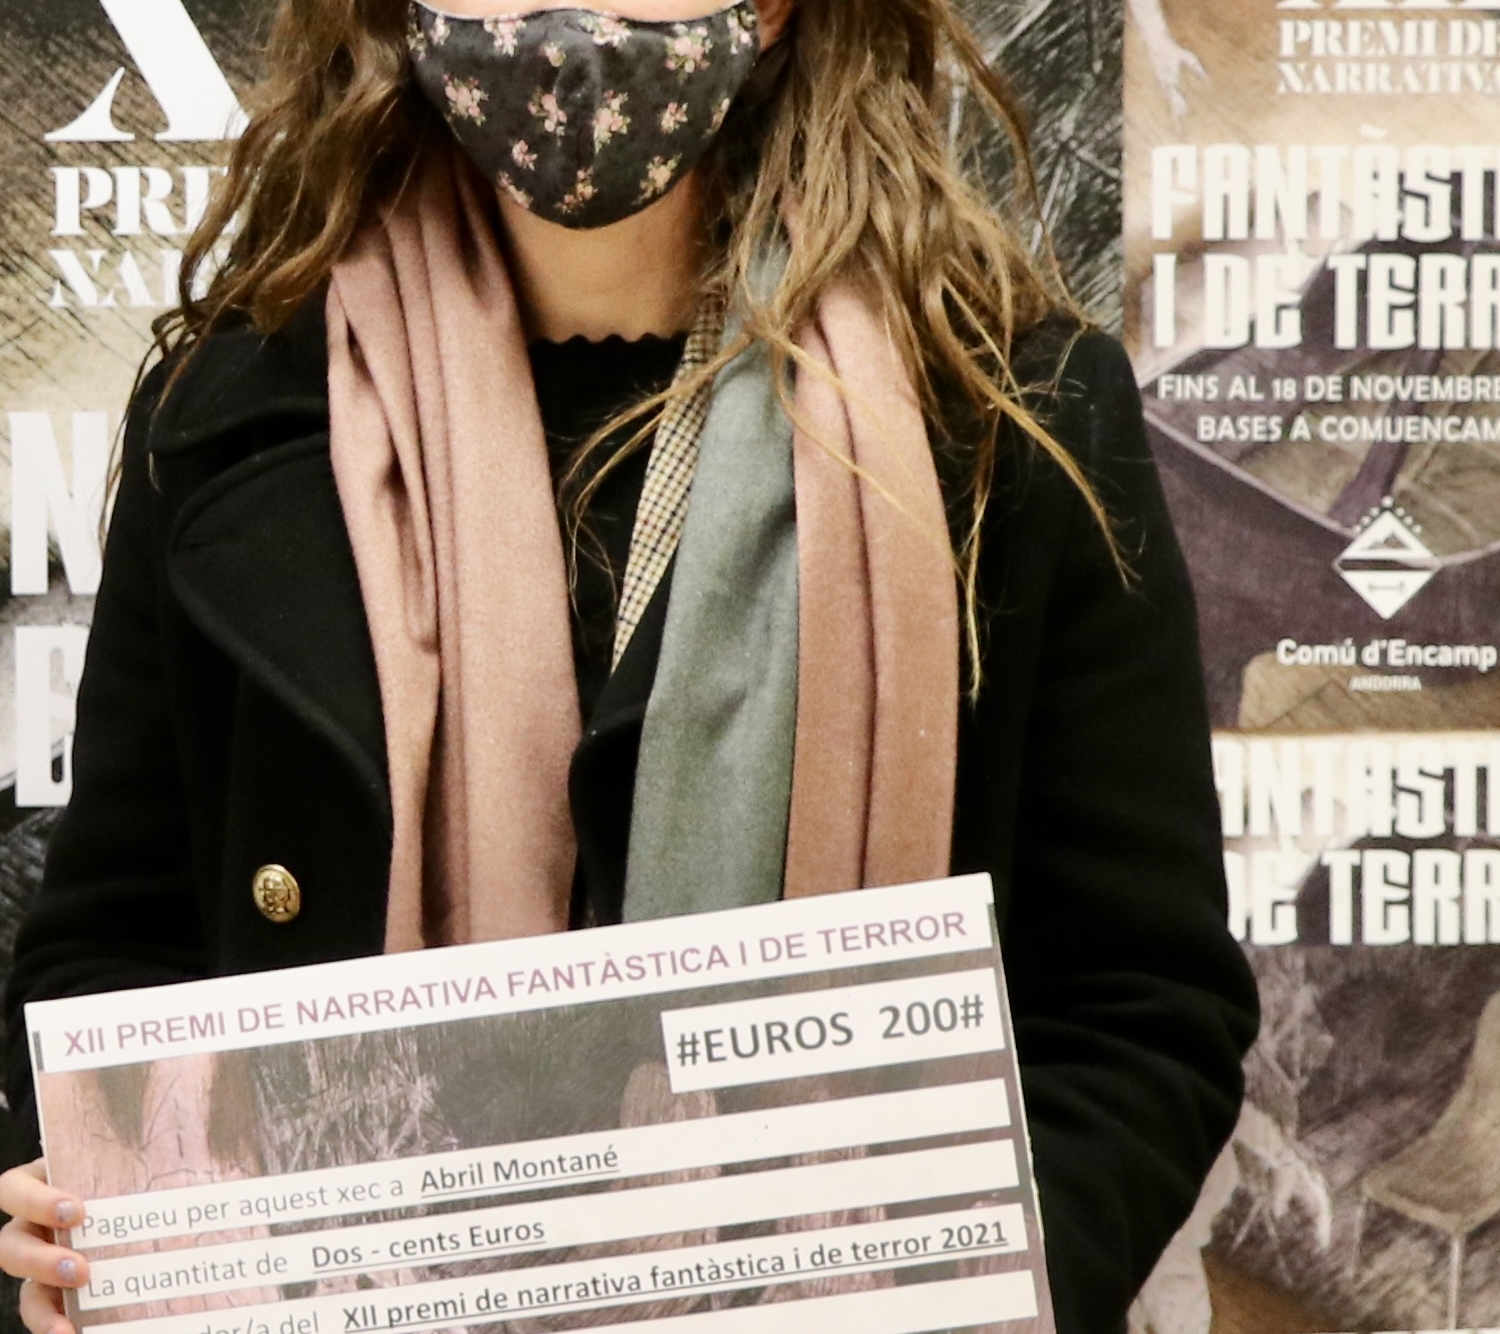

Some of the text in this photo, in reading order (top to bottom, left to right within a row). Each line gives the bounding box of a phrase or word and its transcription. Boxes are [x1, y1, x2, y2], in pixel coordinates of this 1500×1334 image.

[1278, 18, 1443, 58] PREMI
[1151, 253, 1179, 349] I
[1203, 253, 1304, 349] DE
[1158, 375, 1218, 402] FINS
[1228, 376, 1265, 402] AL
[1273, 376, 1298, 402] 18
[1306, 376, 1346, 402] DE
[1197, 416, 1284, 442] BASES
[1289, 416, 1313, 442] A
[1277, 639, 1497, 671] Comú d'Encamp
[64, 911, 966, 1056] XII PREMI DE NARRATIVA FANTÀSTICA I DE TERROR
[676, 993, 983, 1066] #EUROS 200#
[76, 1144, 618, 1239] Pagueu per aquest xec a Abril Montané
[84, 1276, 115, 1298] La
[124, 1258, 246, 1297] quantitat
[255, 1251, 287, 1275] de
[311, 1245, 362, 1268] Dos
[388, 1232, 460, 1258] cents
[468, 1221, 544, 1247] Euros
[342, 1304, 377, 1329] XII
[386, 1291, 469, 1329] premi
[475, 1287, 508, 1312] de
[517, 1272, 641, 1306] narrativa
[649, 1253, 785, 1289] fantàstica
[792, 1247, 800, 1270] i
[809, 1243, 842, 1267] de
[850, 1235, 931, 1261] terror
[940, 1220, 1006, 1250] 2021
